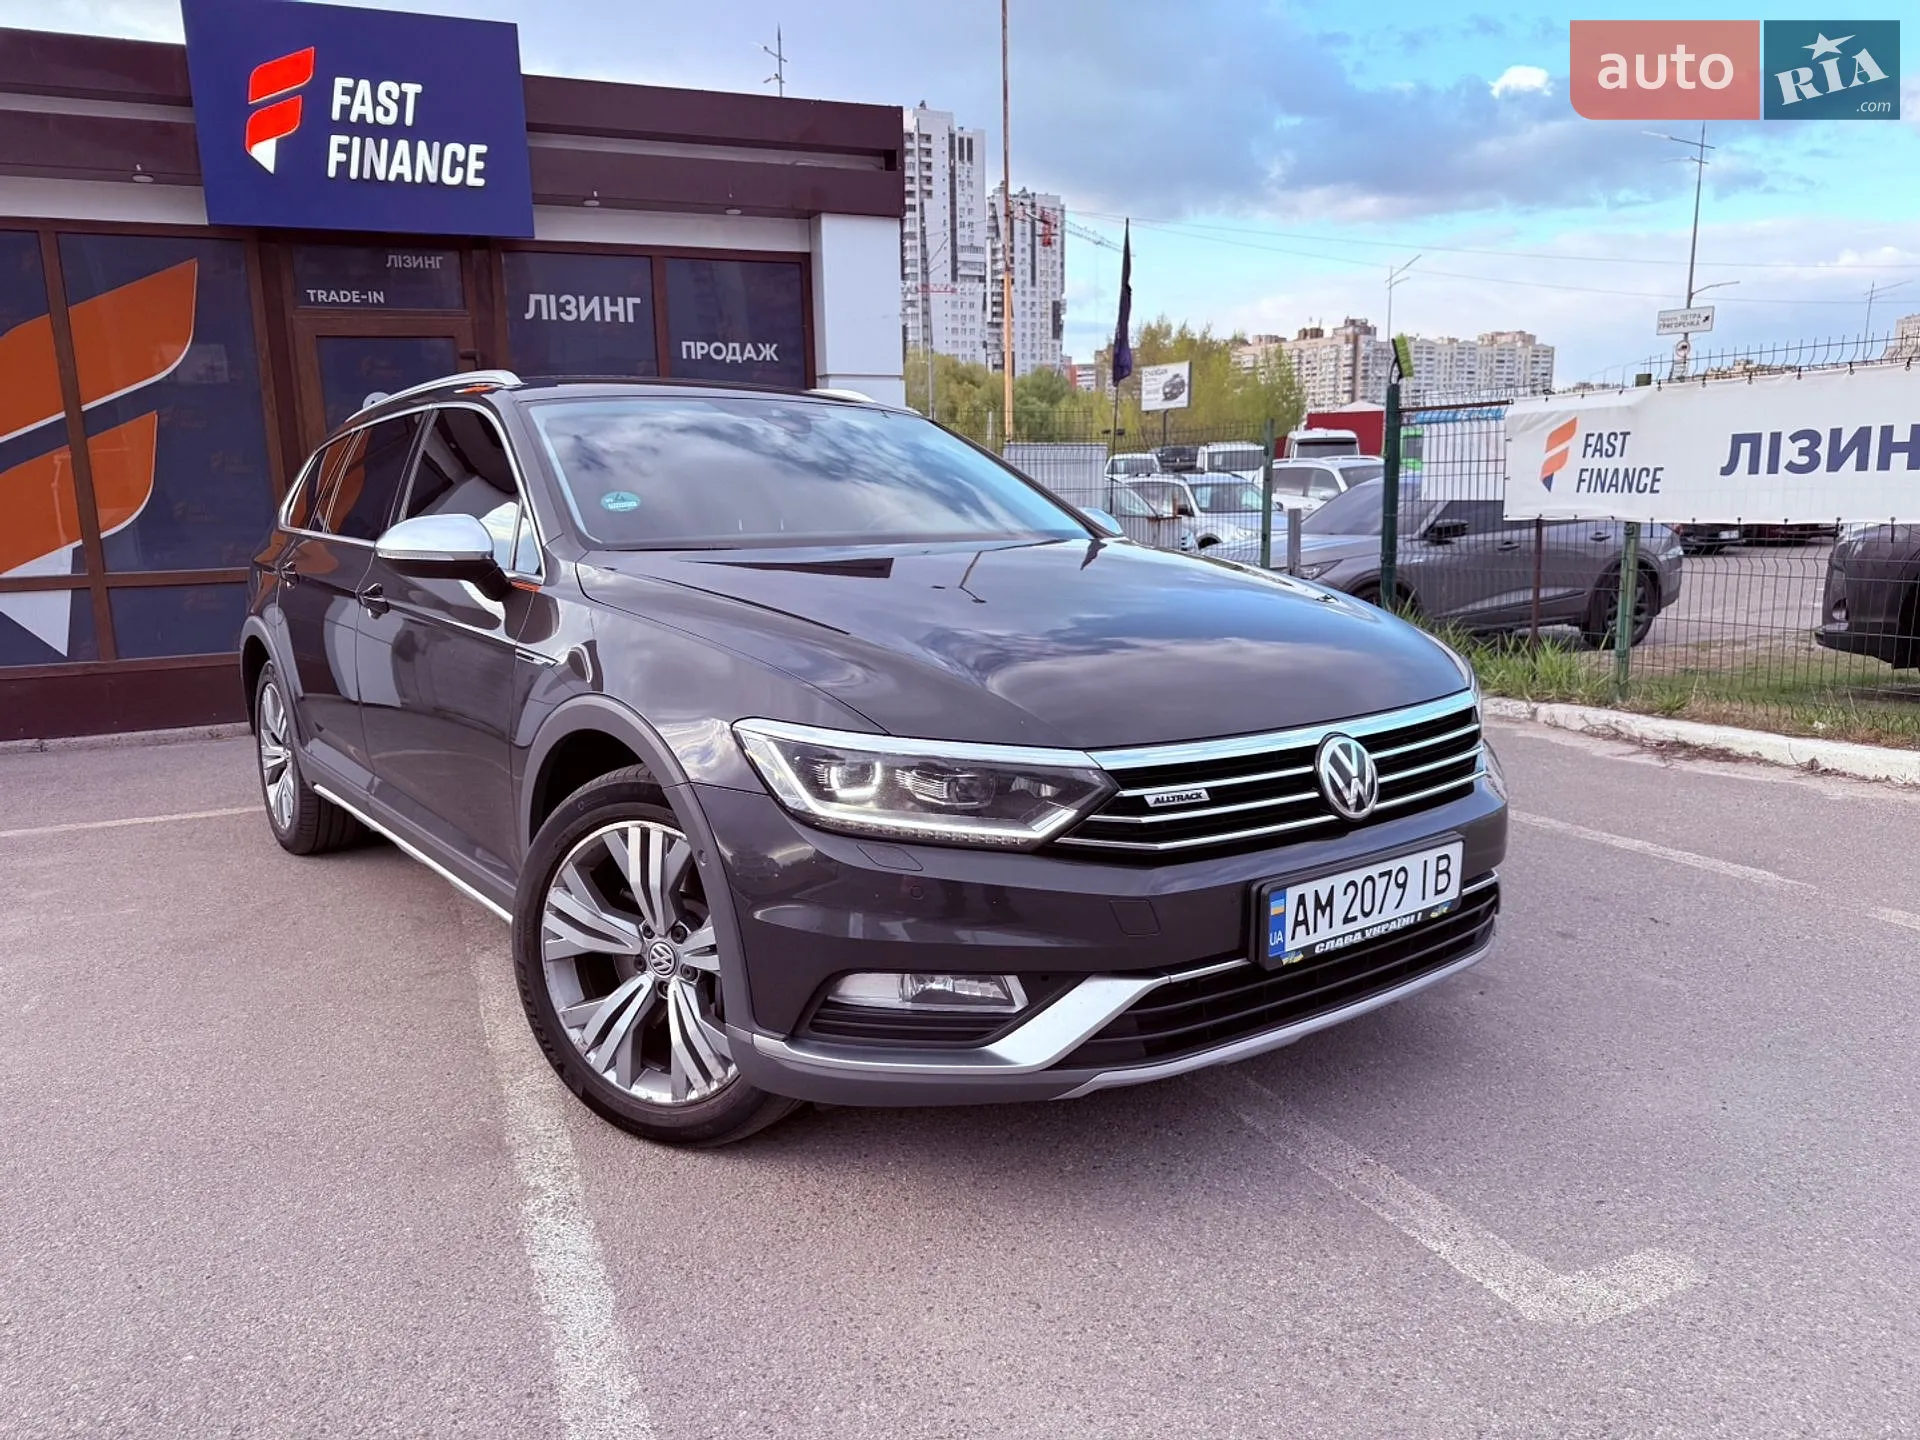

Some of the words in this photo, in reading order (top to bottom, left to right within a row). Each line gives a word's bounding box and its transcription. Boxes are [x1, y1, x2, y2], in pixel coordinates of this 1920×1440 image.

[331, 77, 423, 127] FAST
[327, 134, 488, 187] FINANCE
[386, 254, 443, 269] ЛІЗИНГ
[306, 289, 385, 304] TRADE-IN
[524, 293, 641, 323] ЛІЗИНГ
[681, 340, 779, 364] ПРОДАЖ
[1582, 431, 1631, 459] FAST
[1576, 466, 1664, 494] FINANCE
[1153, 791, 1203, 805] ALLTRACK
[1291, 884, 1335, 941] AM
[1342, 866, 1408, 925] 2079
[1421, 853, 1451, 901] IB
[1269, 932, 1284, 946] UA
[1314, 931, 1363, 954] СЛАВА
